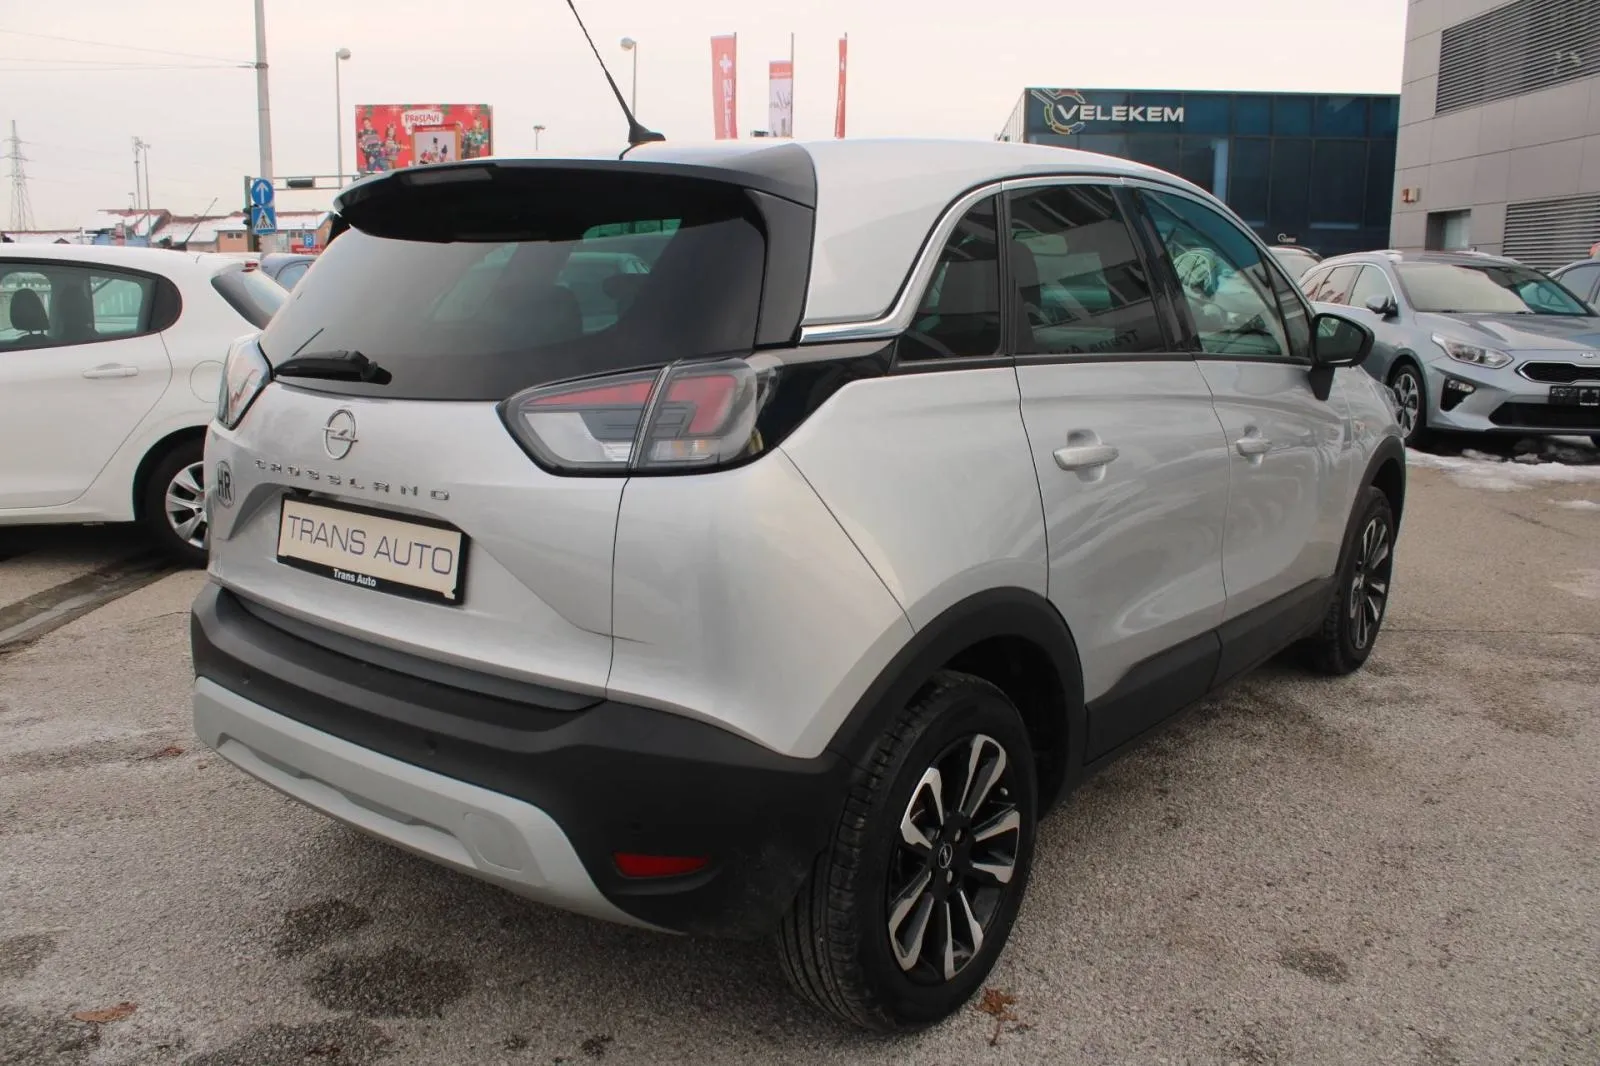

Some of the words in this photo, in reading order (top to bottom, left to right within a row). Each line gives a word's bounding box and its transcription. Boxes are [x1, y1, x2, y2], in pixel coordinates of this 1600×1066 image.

[1057, 104, 1184, 122] VELEKEM
[217, 469, 232, 501] HR
[255, 459, 450, 500] CROSSLAND
[288, 515, 366, 555] TRANS
[373, 536, 453, 575] AUTO
[333, 568, 355, 582] Trans
[356, 573, 376, 587] Auto
